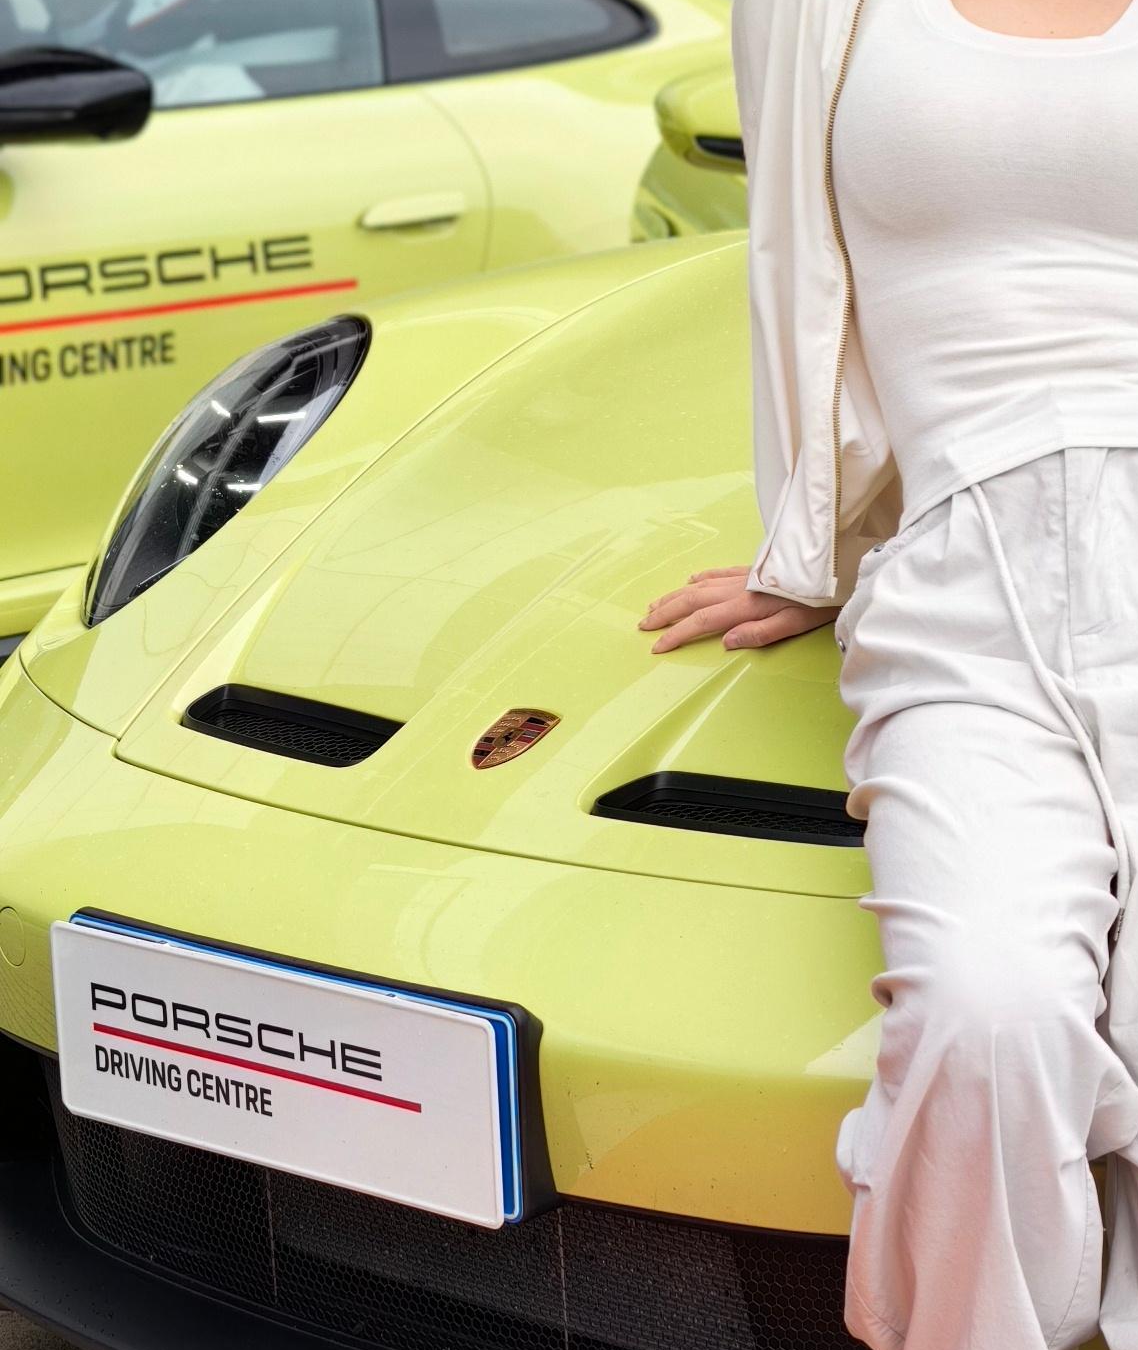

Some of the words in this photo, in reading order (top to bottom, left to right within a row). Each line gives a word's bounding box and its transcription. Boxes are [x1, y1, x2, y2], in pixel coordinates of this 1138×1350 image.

[59, 332, 175, 378] CENTRE
[90, 982, 382, 1082] PORSCHE
[95, 1044, 182, 1092] DRIVING
[187, 1069, 273, 1117] CENTRE
